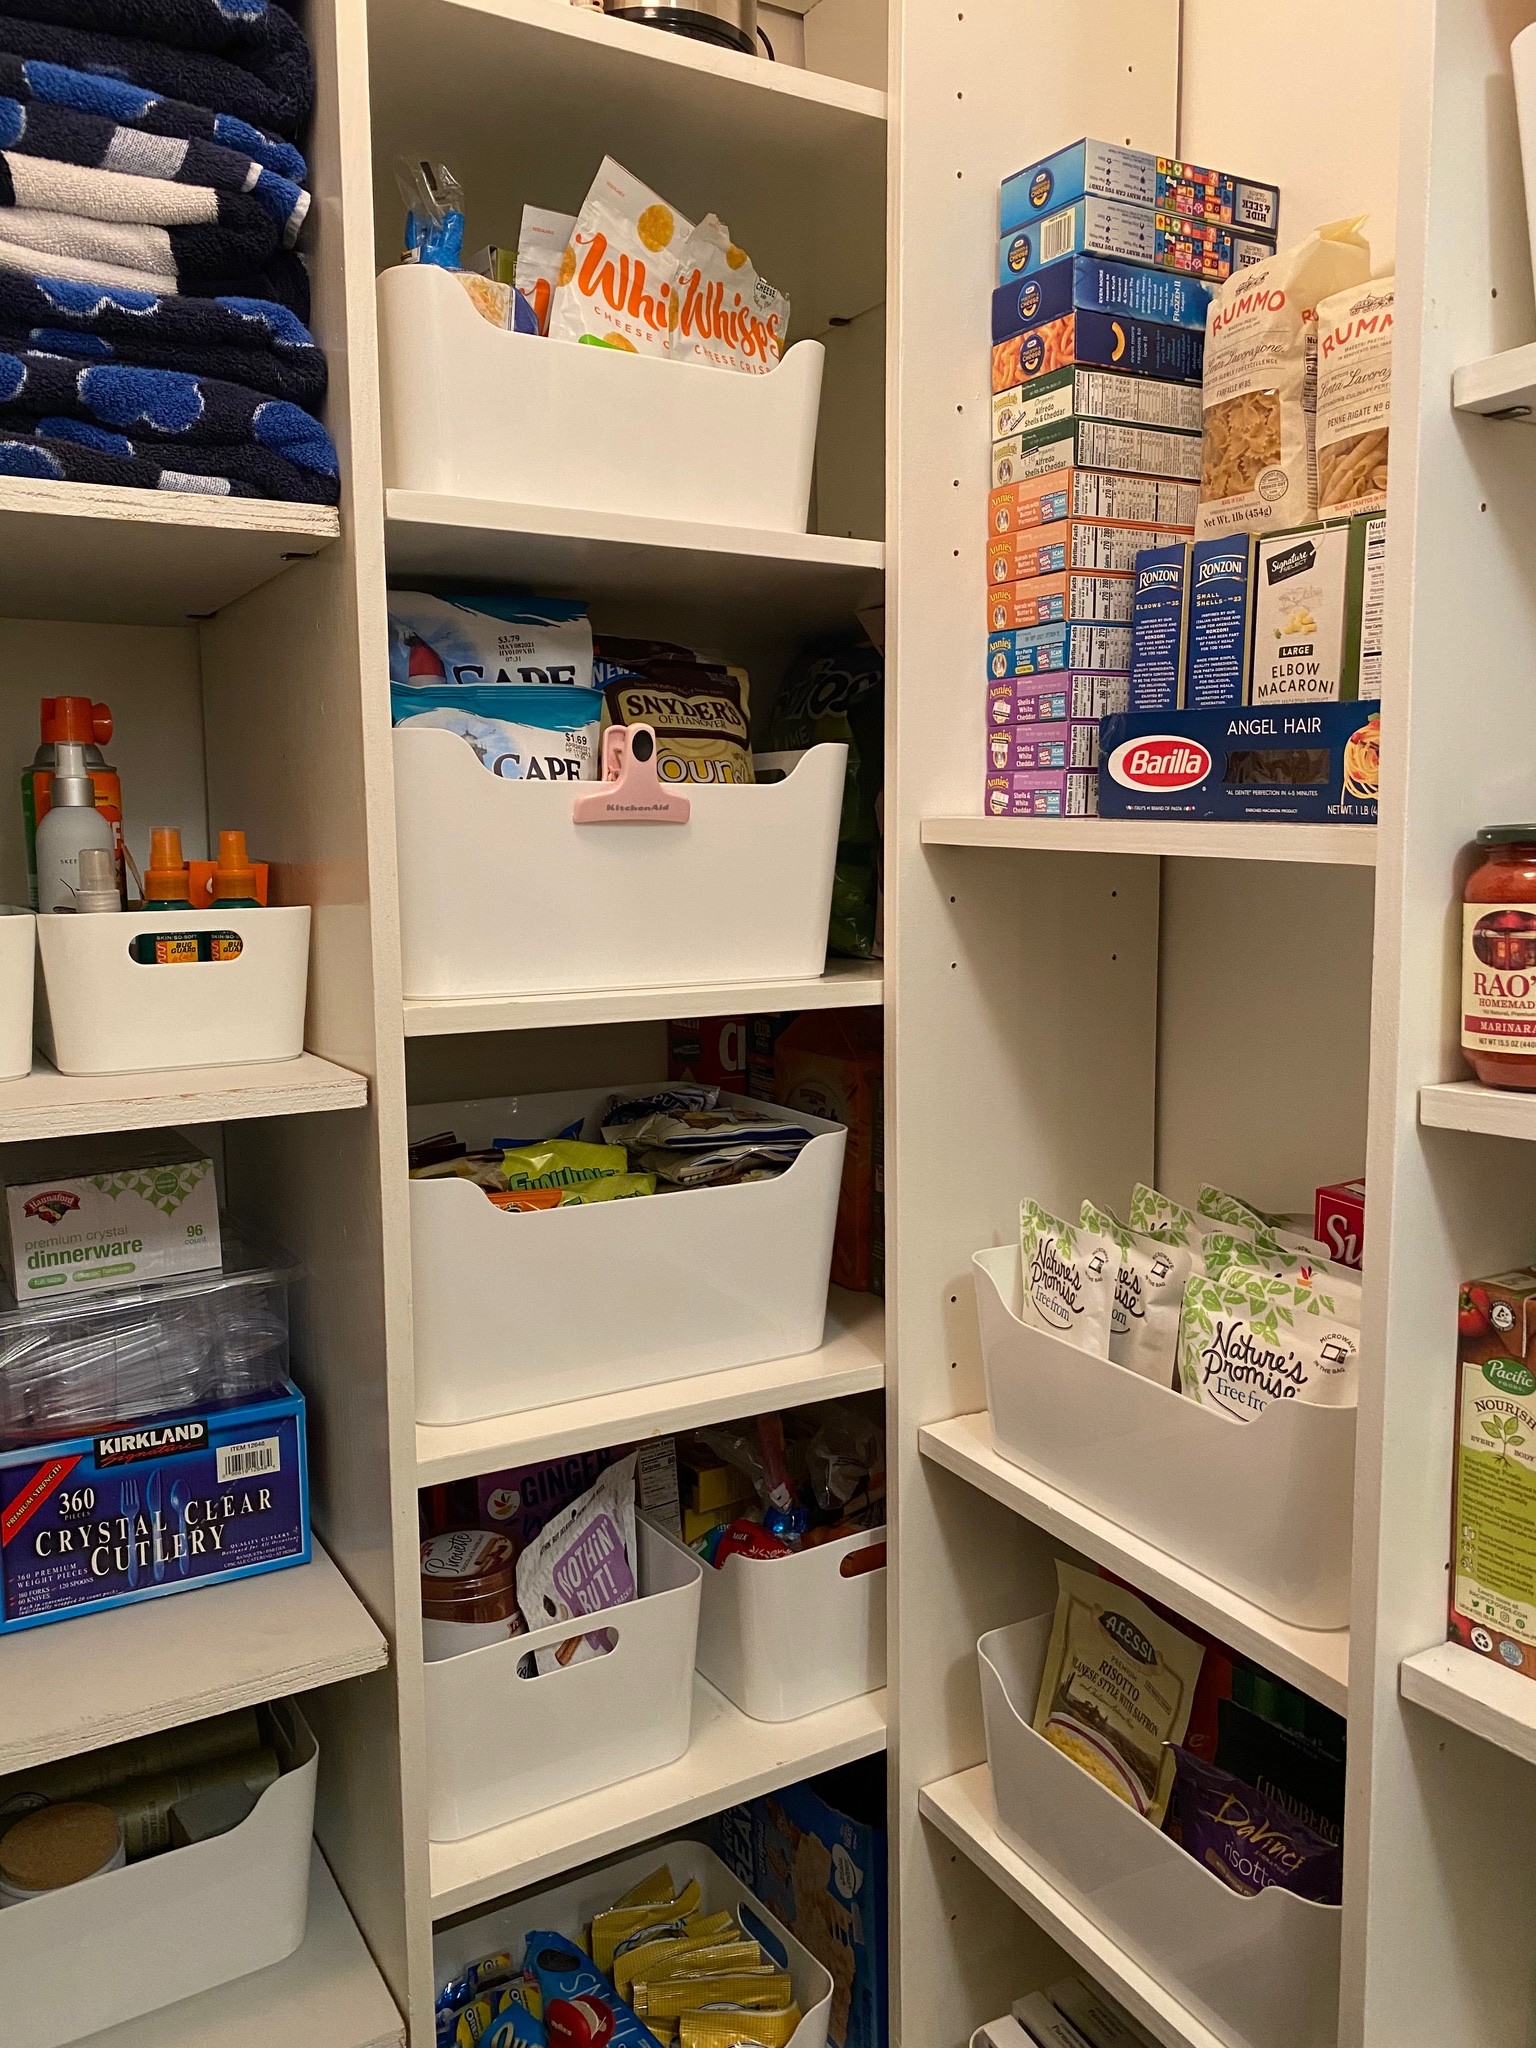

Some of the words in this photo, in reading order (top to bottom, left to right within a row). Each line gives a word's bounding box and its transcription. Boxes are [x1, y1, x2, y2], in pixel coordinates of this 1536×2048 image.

[1242, 199, 1264, 212] SEEK
[1245, 209, 1266, 222] HIDE
[755, 281, 777, 299] CHEESE
[1173, 287, 1181, 322] FROZEN
[1212, 289, 1286, 337] RUMMO
[594, 306, 653, 342] CHEESE
[679, 268, 781, 363] Whisps
[694, 344, 736, 367] CHEESE
[1216, 382, 1238, 398] FARFALLE
[1024, 416, 1039, 428] Shells
[1043, 408, 1066, 421] Cheddar
[1035, 404, 1055, 415] Alfredo
[1327, 413, 1346, 429] PENNE
[1347, 406, 1372, 421] RIGATE
[1024, 466, 1040, 479] Shells
[1044, 460, 1067, 472] Cheddar
[1035, 455, 1055, 466] Alfredo
[991, 492, 1014, 508] Annie's
[1203, 516, 1216, 529] Net
[1216, 513, 1230, 526] Wt.
[1245, 505, 1273, 521] (454g)
[989, 541, 1012, 555] Annie's
[1199, 560, 1242, 581] RONZONI
[1271, 551, 1308, 575] Signature
[1139, 569, 1179, 589] RONZONI
[989, 589, 1012, 602] Annie's
[1196, 599, 1223, 607] SHELLS
[1135, 602, 1161, 611] ELBOWS
[497, 634, 520, 644] $3.79
[989, 637, 1012, 652] Annie's
[1282, 646, 1310, 656] LARGE
[1271, 662, 1320, 679] ELBOW
[989, 684, 1013, 698] Annie's
[1072, 676, 1080, 692] Facts
[1258, 678, 1334, 699] MACARONI
[625, 694, 742, 726] SNYDER'S
[1017, 698, 1030, 706] Shells
[658, 714, 675, 724] OF
[675, 716, 727, 729] HANOVER
[1016, 713, 1036, 721] Cheddar
[1227, 718, 1278, 736] ANGEL
[1283, 716, 1322, 734] HAIR
[564, 732, 587, 746] $1.69
[1016, 745, 1030, 753] Shells
[1018, 752, 1033, 760] White
[1070, 743, 1078, 766] Nutrition
[1129, 748, 1203, 775] Barilla
[493, 753, 581, 780] CAPE
[987, 775, 1009, 789] Annie's
[606, 804, 669, 812] KitchenAid
[1012, 806, 1032, 814] Cheddar
[1327, 804, 1341, 815] NET
[1359, 804, 1370, 815] LB
[170, 946, 196, 954] GUARD
[175, 941, 192, 949] BUG
[1497, 1039, 1510, 1047] 15.5
[28, 1192, 75, 1210] Hannaford
[25, 1231, 83, 1253] premium
[86, 1224, 129, 1242] crystal
[184, 1235, 207, 1246] count
[186, 1224, 204, 1238] 96
[27, 1239, 144, 1270] dinnerware
[1035, 1237, 1082, 1291] Nature's
[1030, 1261, 1085, 1314] Promise
[1035, 1284, 1052, 1308] Free
[1051, 1296, 1070, 1322] from
[1211, 1320, 1309, 1385] Nature's
[1319, 1332, 1357, 1354] MICROWAVE
[1201, 1349, 1297, 1399] Promise
[1487, 1359, 1534, 1388] Pacific
[1215, 1376, 1246, 1404] Free
[1474, 1400, 1536, 1431] NOURISH
[99, 1422, 204, 1456] KIRKLAND
[1470, 1435, 1495, 1448] EVERY
[1514, 1449, 1535, 1461] BODY
[6, 1496, 34, 1528] PREMIUM
[32, 1463, 63, 1499] STRENGTH
[58, 1487, 95, 1515] 360
[35, 1510, 168, 1557] CRYSTAL
[184, 1488, 273, 1525] CLEAR
[64, 1511, 91, 1521] PIECES
[90, 1524, 225, 1576] CUTLERY
[424, 1532, 473, 1574] Pirouette
[557, 1518, 615, 1599] NOTHIN'
[16, 1572, 32, 1582] 360
[34, 1562, 77, 1578] PREMIUM
[17, 1575, 53, 1589] WEIGHT
[56, 1567, 88, 1580] PIECES
[69, 1576, 94, 1588] SPOONS
[26, 1593, 50, 1604] KNIVES
[29, 1586, 50, 1597] FORKS
[576, 1563, 619, 1616] BUT!
[1105, 1615, 1154, 1662] ALESSI
[1110, 1655, 1138, 1681] PREMIUM
[1099, 1659, 1140, 1701] RISOTTO
[1097, 1676, 1119, 1701] STYLE
[1133, 1707, 1160, 1737] SAFFRON
[1205, 1788, 1306, 1872] DaVinci
